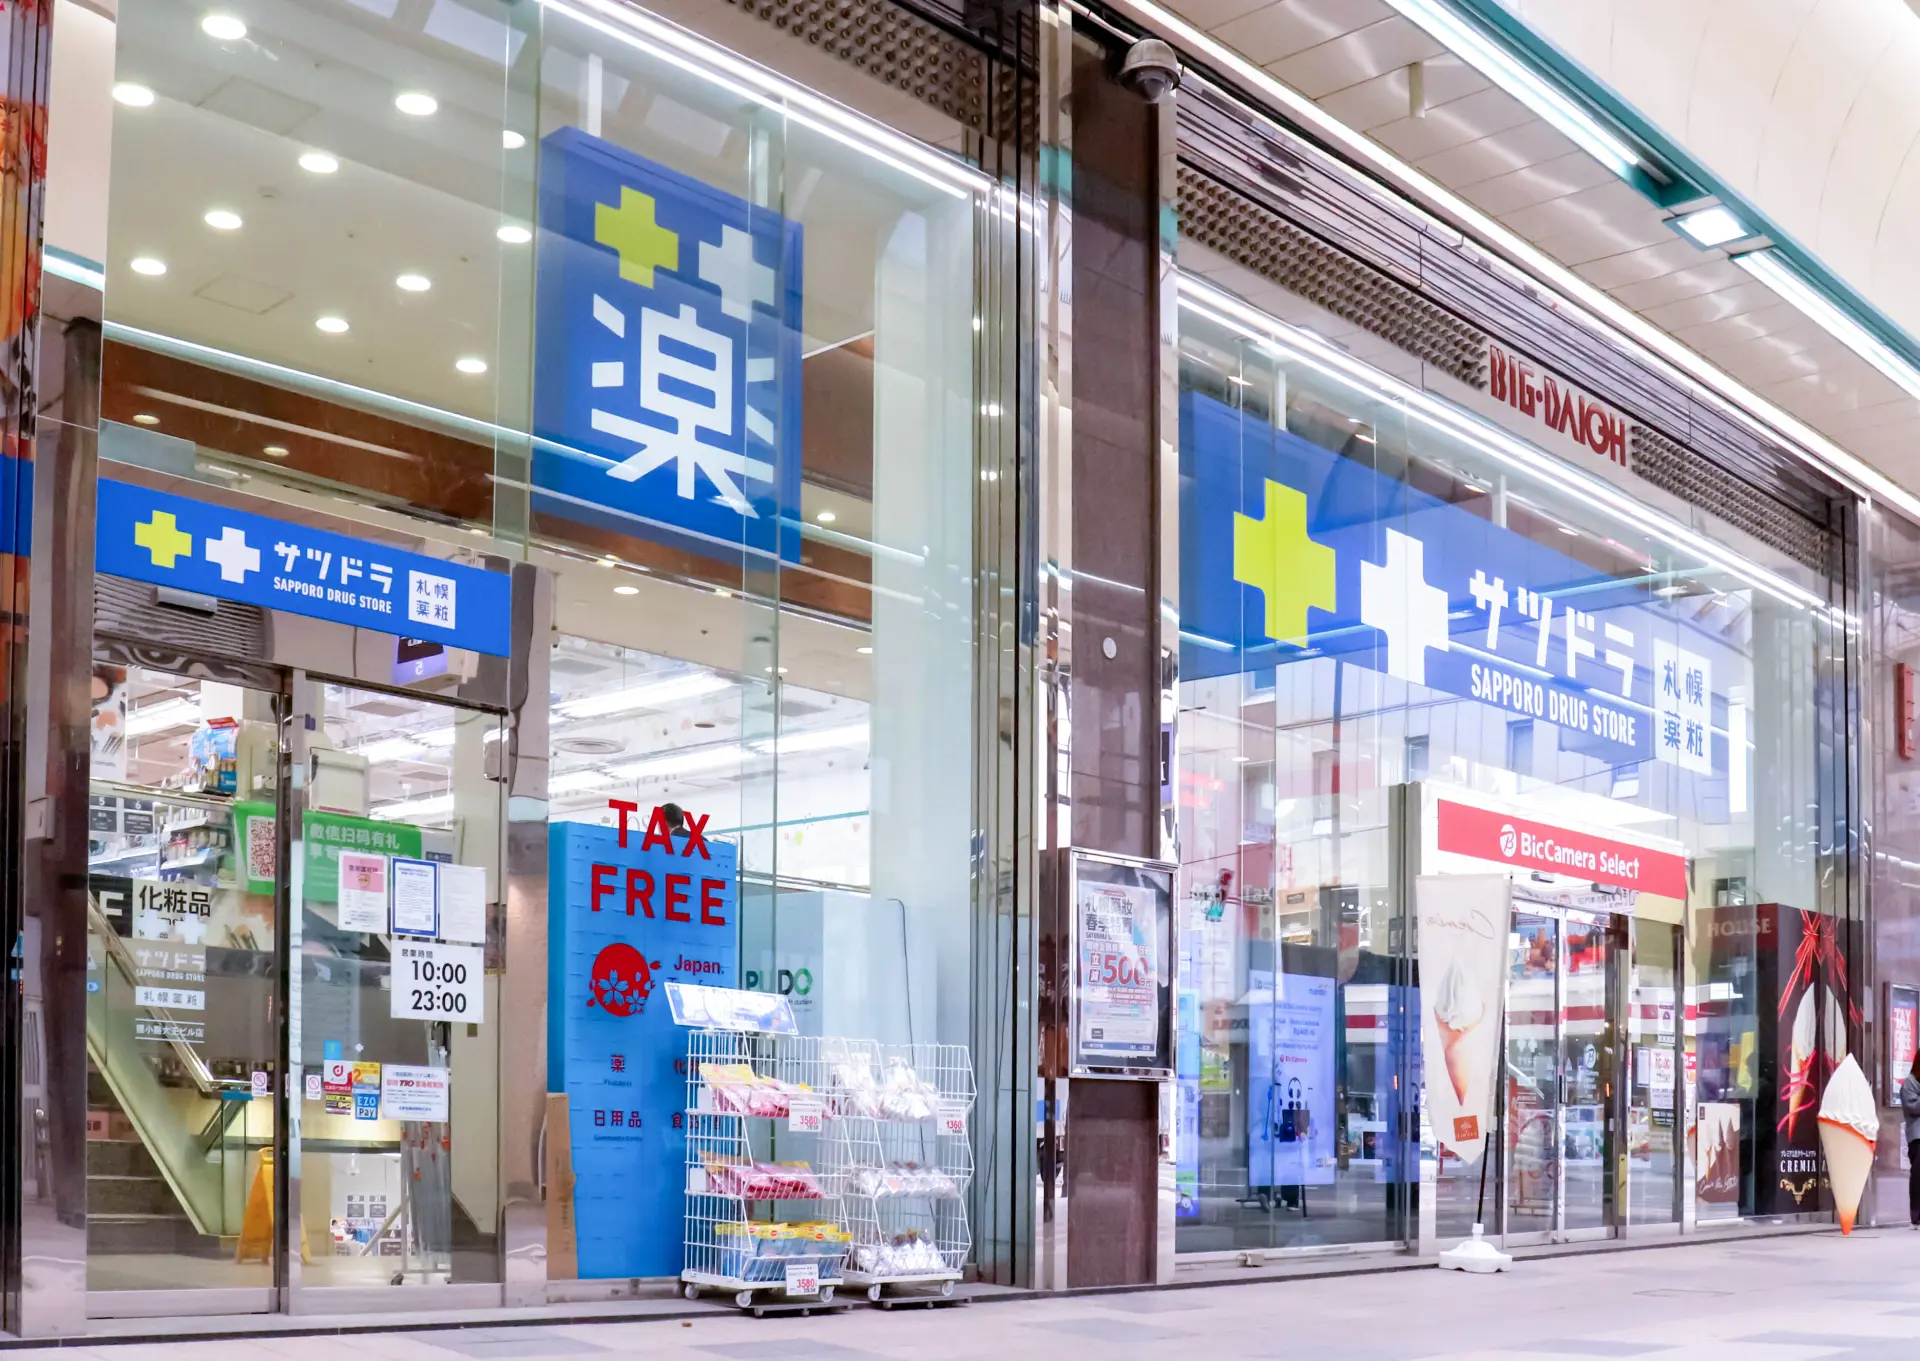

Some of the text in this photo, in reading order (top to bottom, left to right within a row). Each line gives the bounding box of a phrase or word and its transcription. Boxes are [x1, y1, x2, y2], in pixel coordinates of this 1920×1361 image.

[274, 541, 393, 595] サツドラ
[273, 576, 392, 614] SAPPORO DRUG STORE
[416, 578, 449, 601] 札幌
[416, 600, 449, 622] 薬粧
[1469, 569, 1634, 699] サツドラ
[1663, 659, 1704, 707] 札幌
[1471, 663, 1636, 747] SAPPORO DRUG STORE
[1663, 710, 1704, 757] 薬粧
[608, 799, 711, 860] TAX
[1521, 832, 1596, 870] BicCamera
[1600, 851, 1640, 880] Select
[139, 885, 211, 918] 化粧品
[591, 864, 726, 926] FREE
[411, 960, 467, 984] 10:00
[411, 989, 467, 1013] 23:00
[611, 1054, 625, 1073] 薬
[357, 1096, 376, 1107] EZO
[358, 1108, 376, 1120] Pay
[594, 1110, 642, 1128] 日用品
[800, 1115, 818, 1125] 3580
[1780, 1159, 1816, 1173] CREMIA
[796, 1278, 815, 1289] 3580
